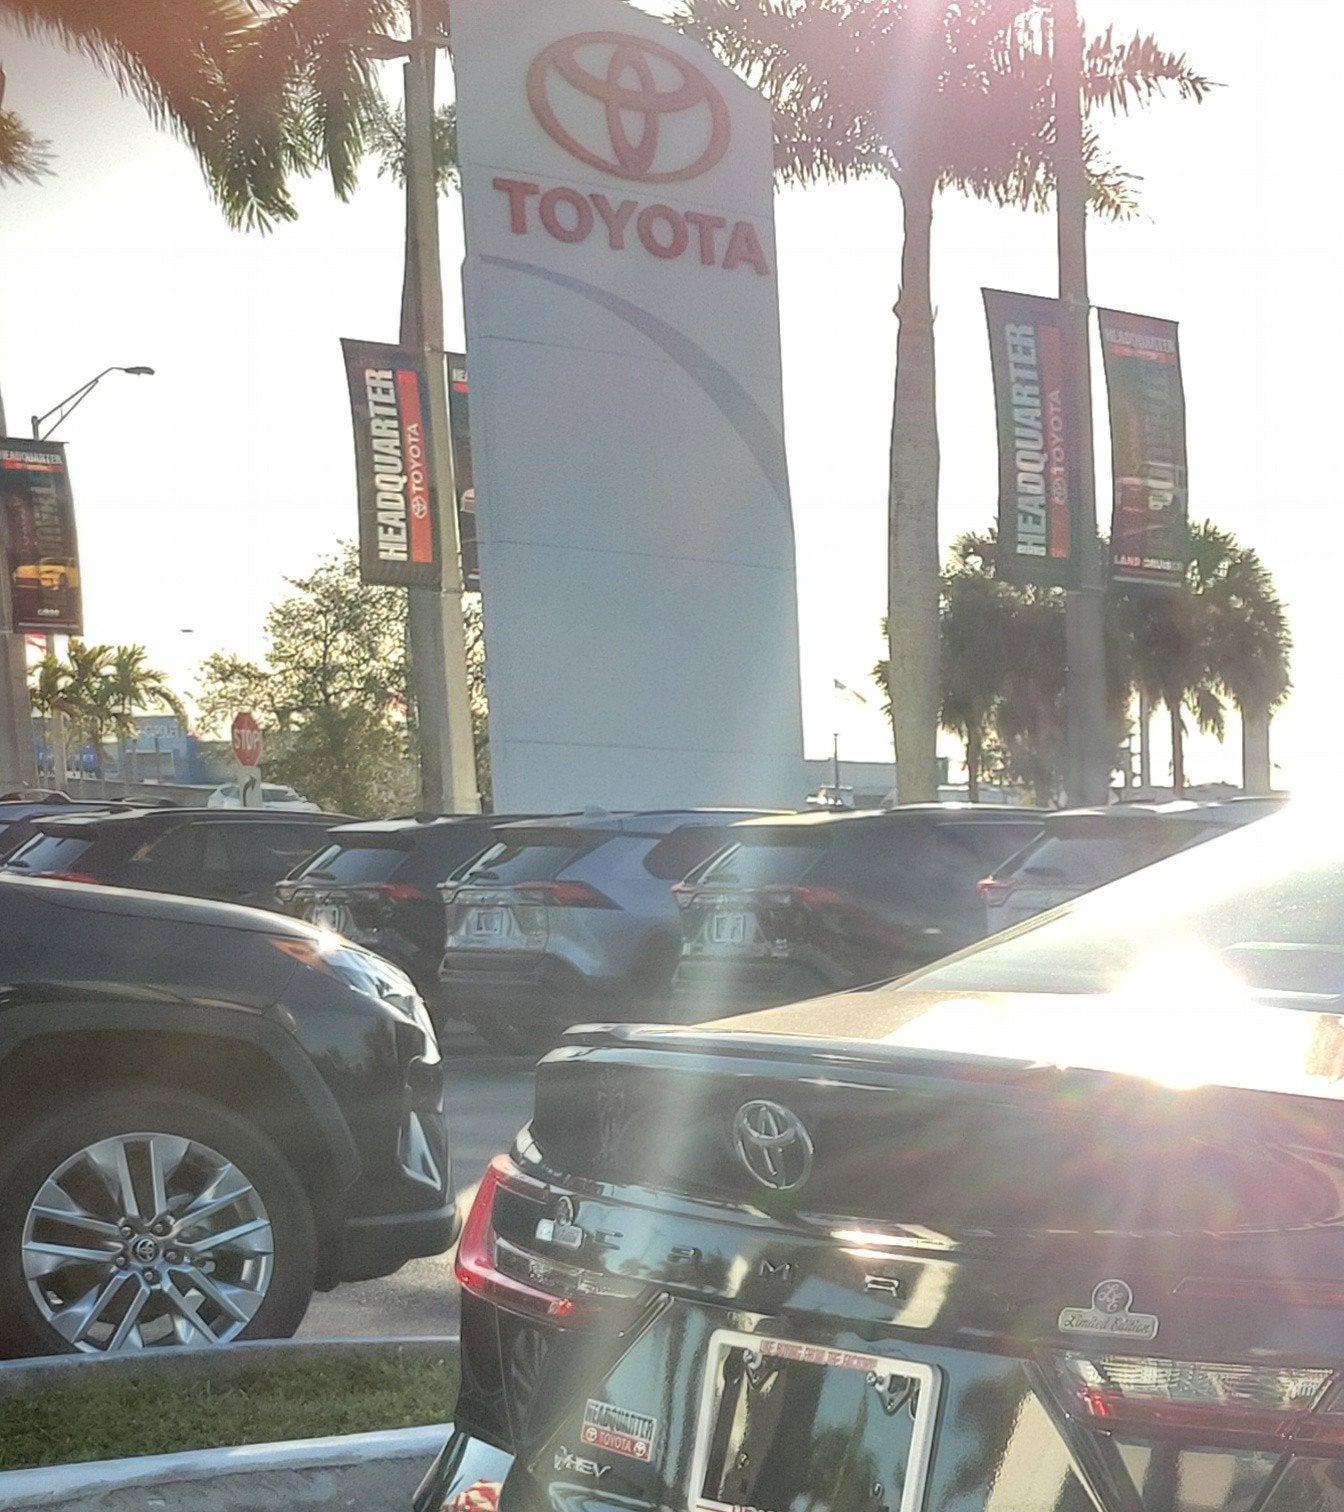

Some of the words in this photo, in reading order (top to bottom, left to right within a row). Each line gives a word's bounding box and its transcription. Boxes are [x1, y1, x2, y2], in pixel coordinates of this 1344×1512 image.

[492, 177, 771, 276] TOYOTA
[365, 368, 408, 562] HEADQUARTER
[407, 423, 425, 494] TOYOTA
[1005, 323, 1048, 557] HEADQUARTER
[1048, 390, 1066, 475] TOYOTA
[233, 728, 261, 750] STOP
[1063, 1313, 1108, 1331] Limited
[584, 1402, 654, 1442] HEADQUARTER
[598, 1431, 633, 1453] TOYOTA
